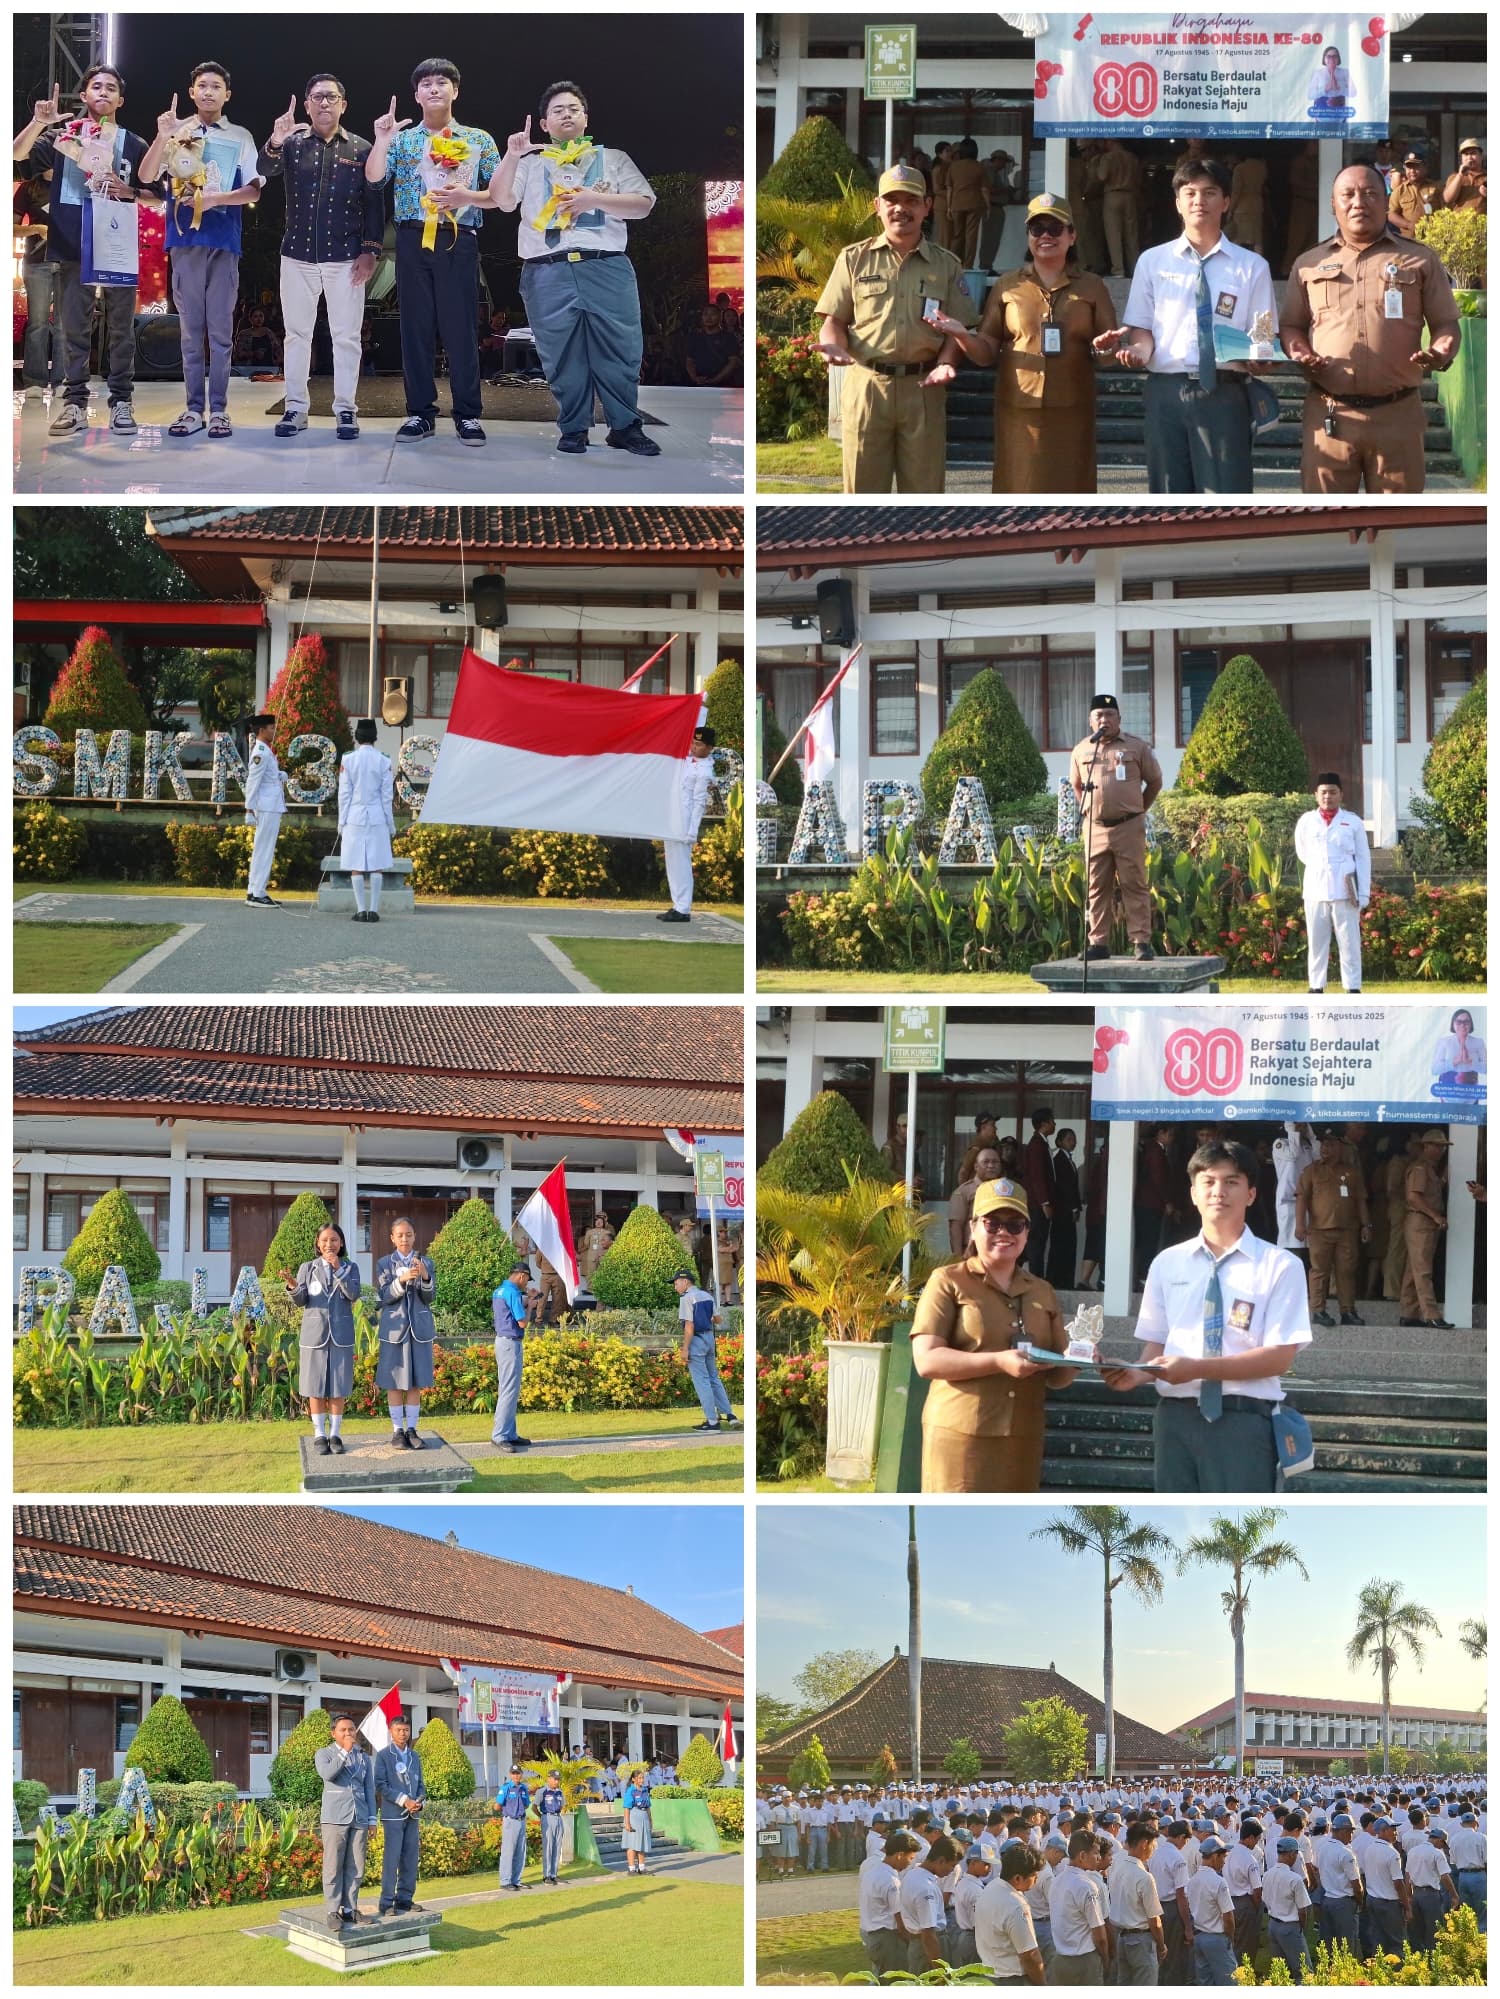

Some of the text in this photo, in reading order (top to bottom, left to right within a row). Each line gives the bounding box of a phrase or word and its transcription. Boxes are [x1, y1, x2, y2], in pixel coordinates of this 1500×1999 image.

[1100, 32, 1323, 46] REPUBLIK INDONESIA KE-80
[1164, 49, 1193, 58] Agustus
[1225, 49, 1253, 58] Agustus
[1163, 70, 1267, 82] Bersatu Berdaulat
[1093, 61, 1158, 118] 80
[1163, 84, 1261, 98] Rakyat Sejahtera
[1163, 98, 1248, 113] Indonesia Maju
[12, 725, 255, 804] SMKN
[287, 734, 336, 804] 3
[1242, 1012, 1251, 1020] 17
[1253, 1012, 1288, 1021] Agustus
[1290, 1012, 1309, 1020] 1945
[1316, 1012, 1326, 1020] 17
[1328, 1012, 1362, 1021] Agustus
[1364, 1012, 1385, 1020] 2025
[1251, 1038, 1379, 1052] Bersatu Berdaulat
[1164, 1027, 1244, 1096] 80
[1250, 1055, 1372, 1071] Rakyat Sejahtera
[1250, 1072, 1356, 1090] Indonesia Maju
[1442, 1111, 1477, 1122] singaraja
